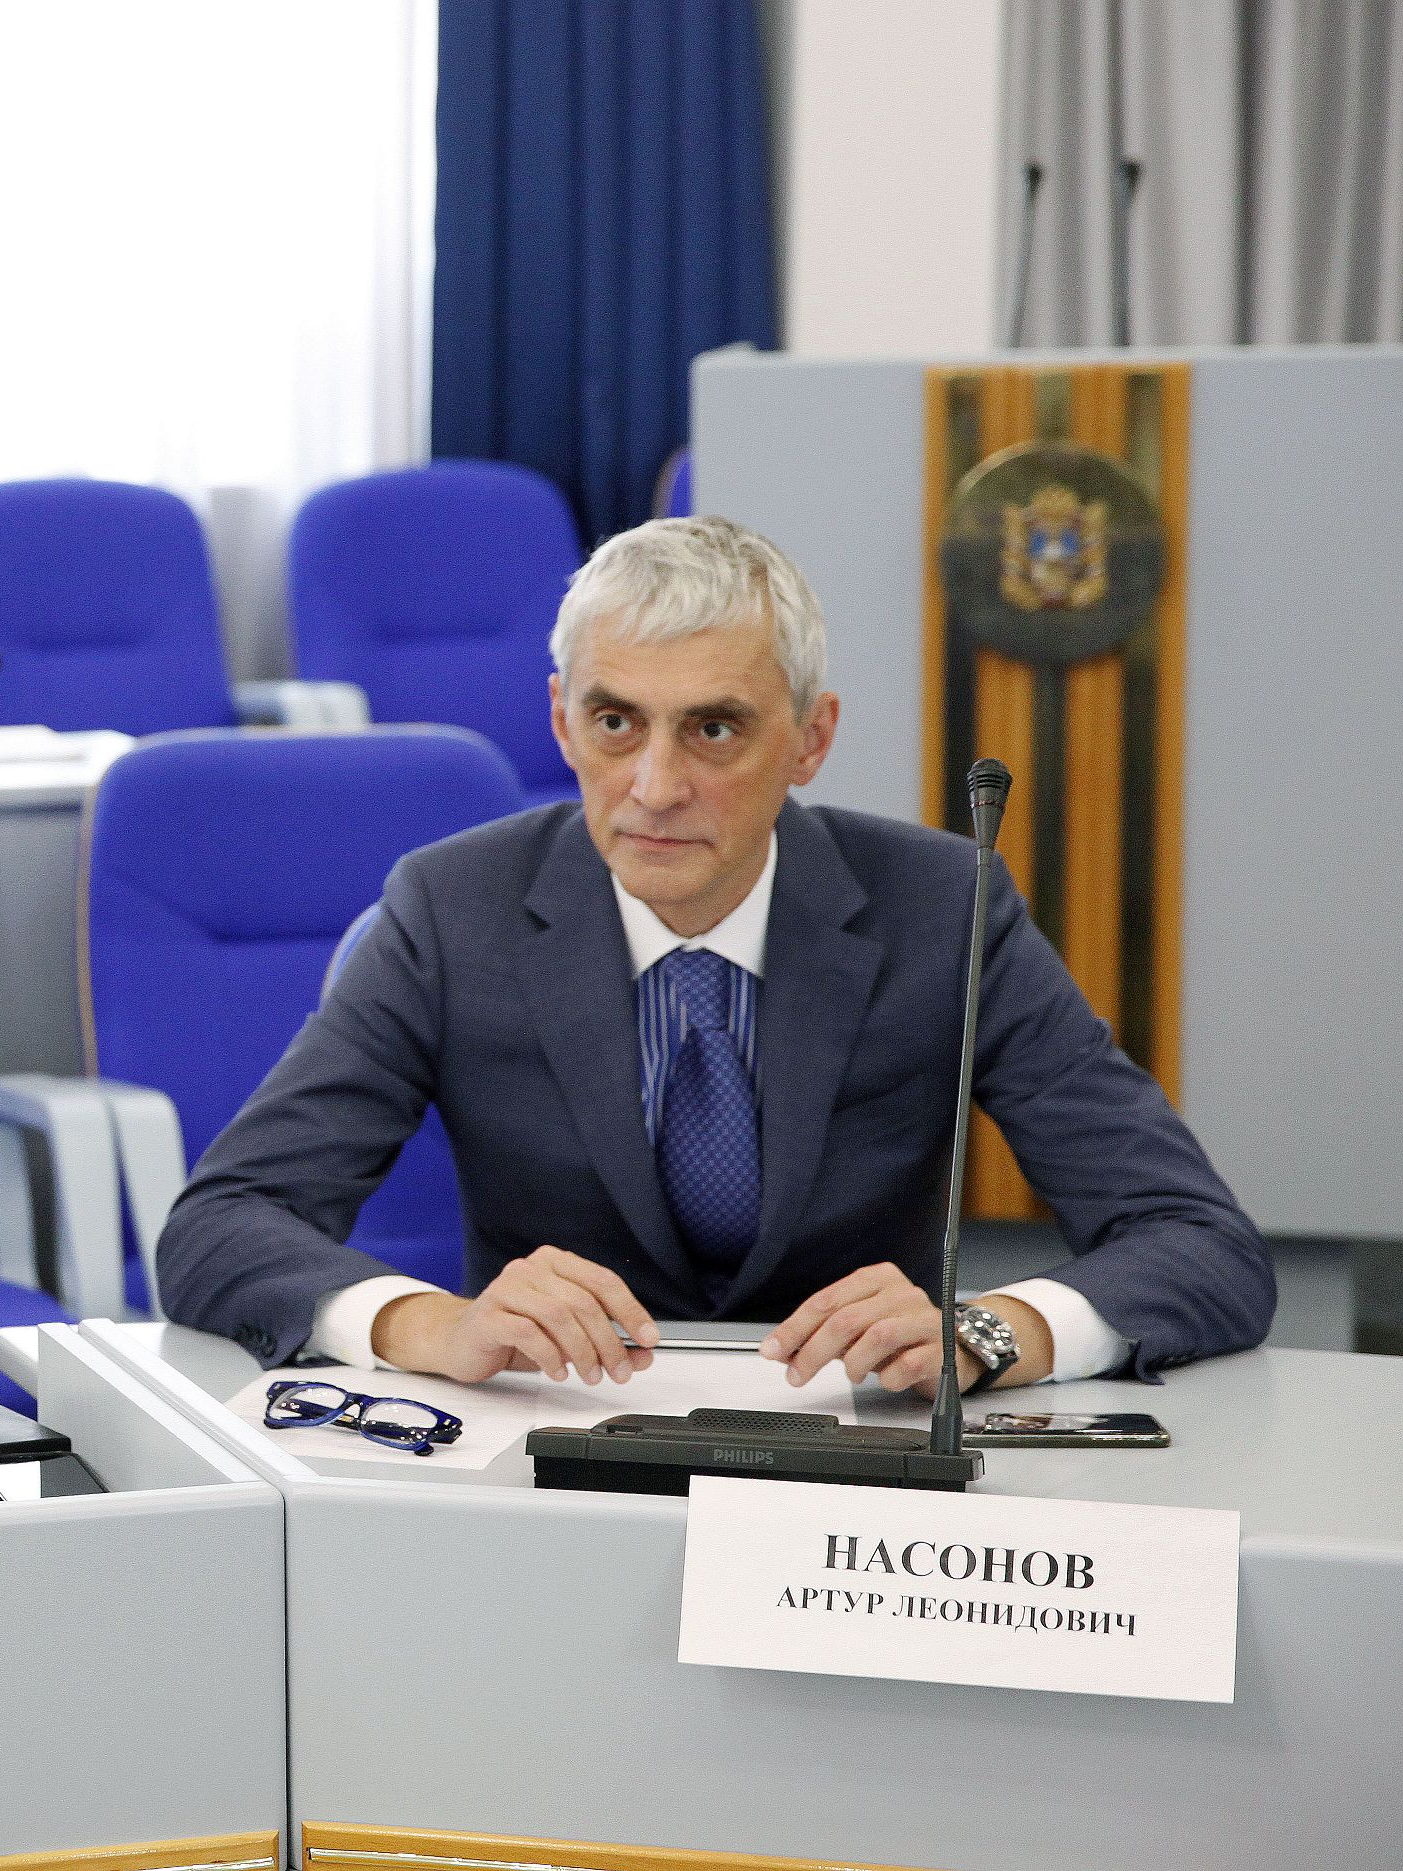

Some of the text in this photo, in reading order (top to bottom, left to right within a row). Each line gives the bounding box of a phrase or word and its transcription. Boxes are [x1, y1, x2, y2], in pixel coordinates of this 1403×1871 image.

[713, 1449, 774, 1465] PHILIPS
[823, 1533, 1097, 1591] НАСОНОВ
[775, 1585, 1139, 1638] АРТУР ЛЕОНИДОВИЧ
